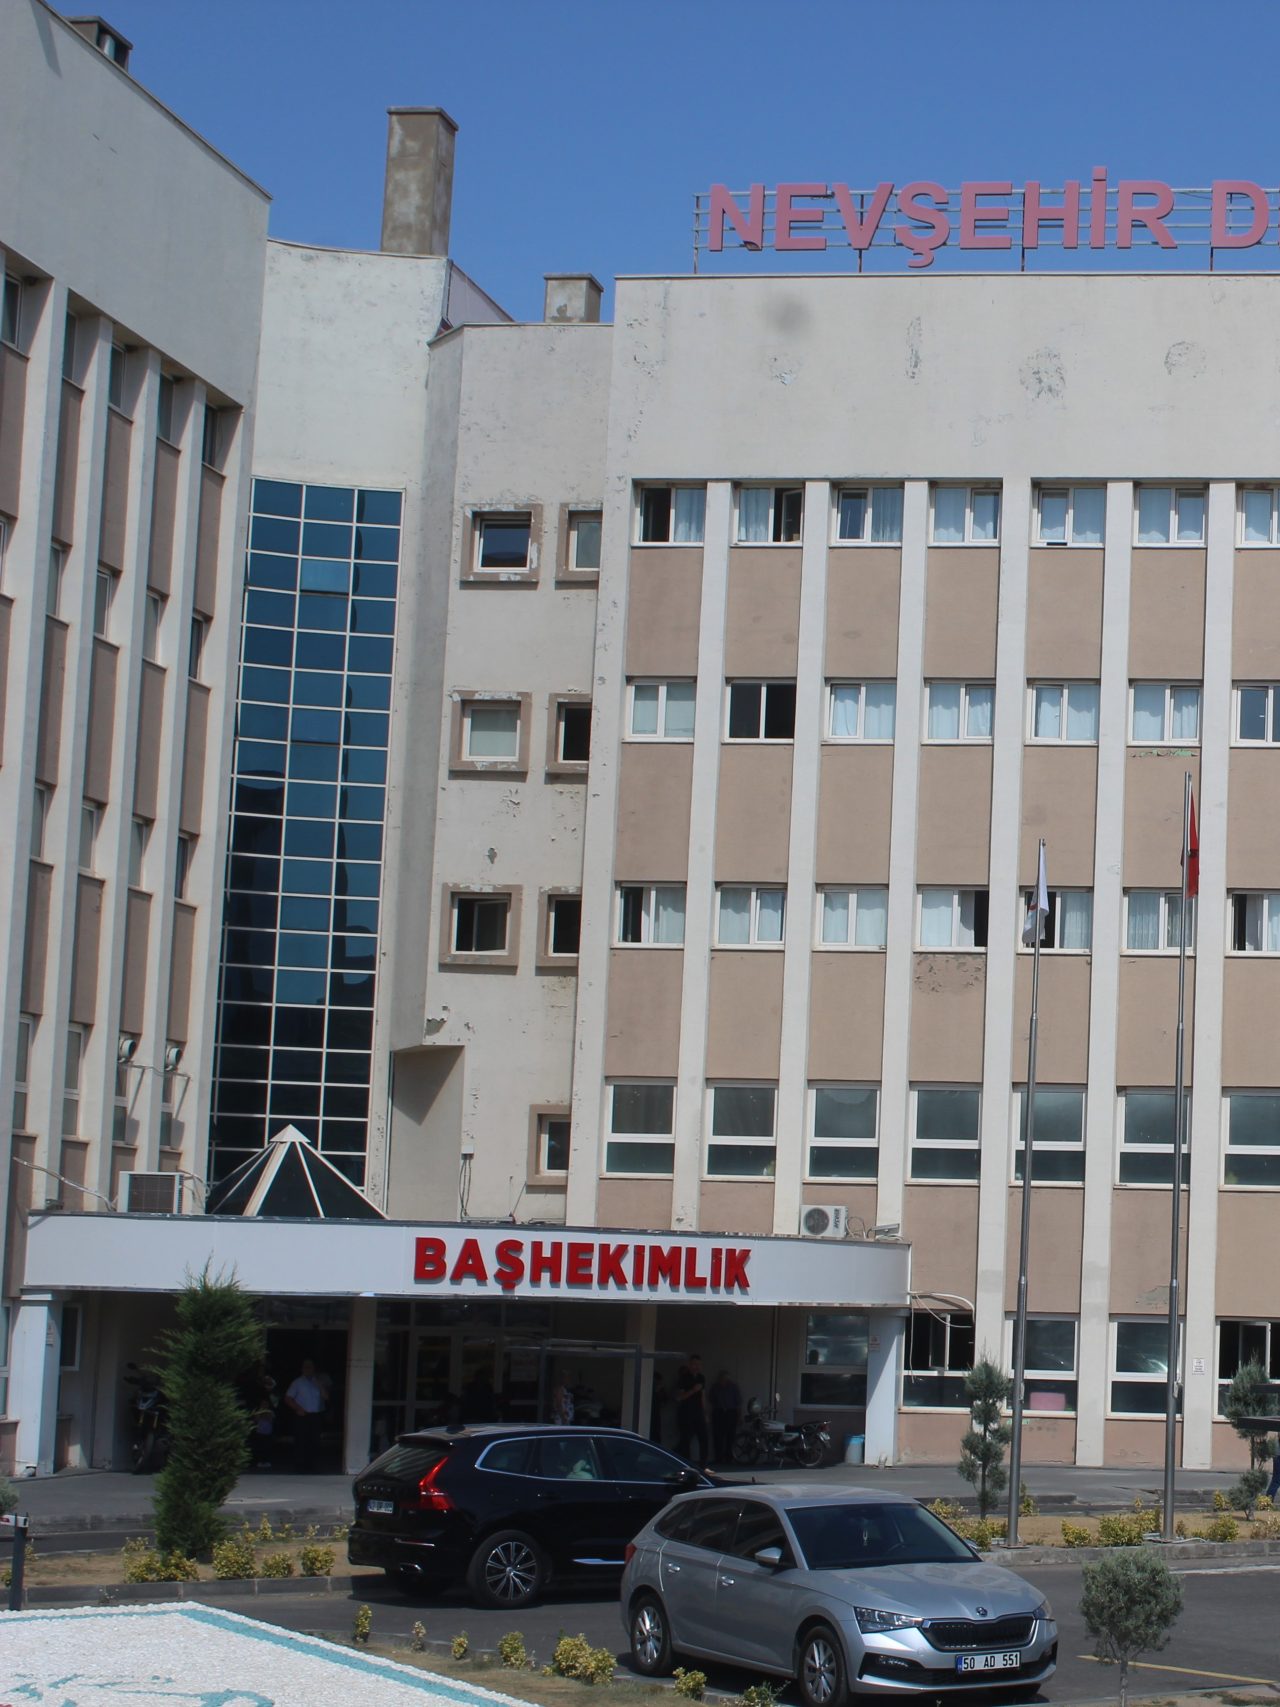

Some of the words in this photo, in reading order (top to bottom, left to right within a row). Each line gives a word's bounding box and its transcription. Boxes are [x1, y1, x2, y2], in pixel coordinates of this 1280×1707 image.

[709, 165, 1178, 269] NEVŞEHİR
[414, 1236, 752, 1290] BAŞHEKİMLİK
[963, 1658, 975, 1669] 50
[983, 1655, 996, 1668] AD
[1002, 1653, 1019, 1667] 551
